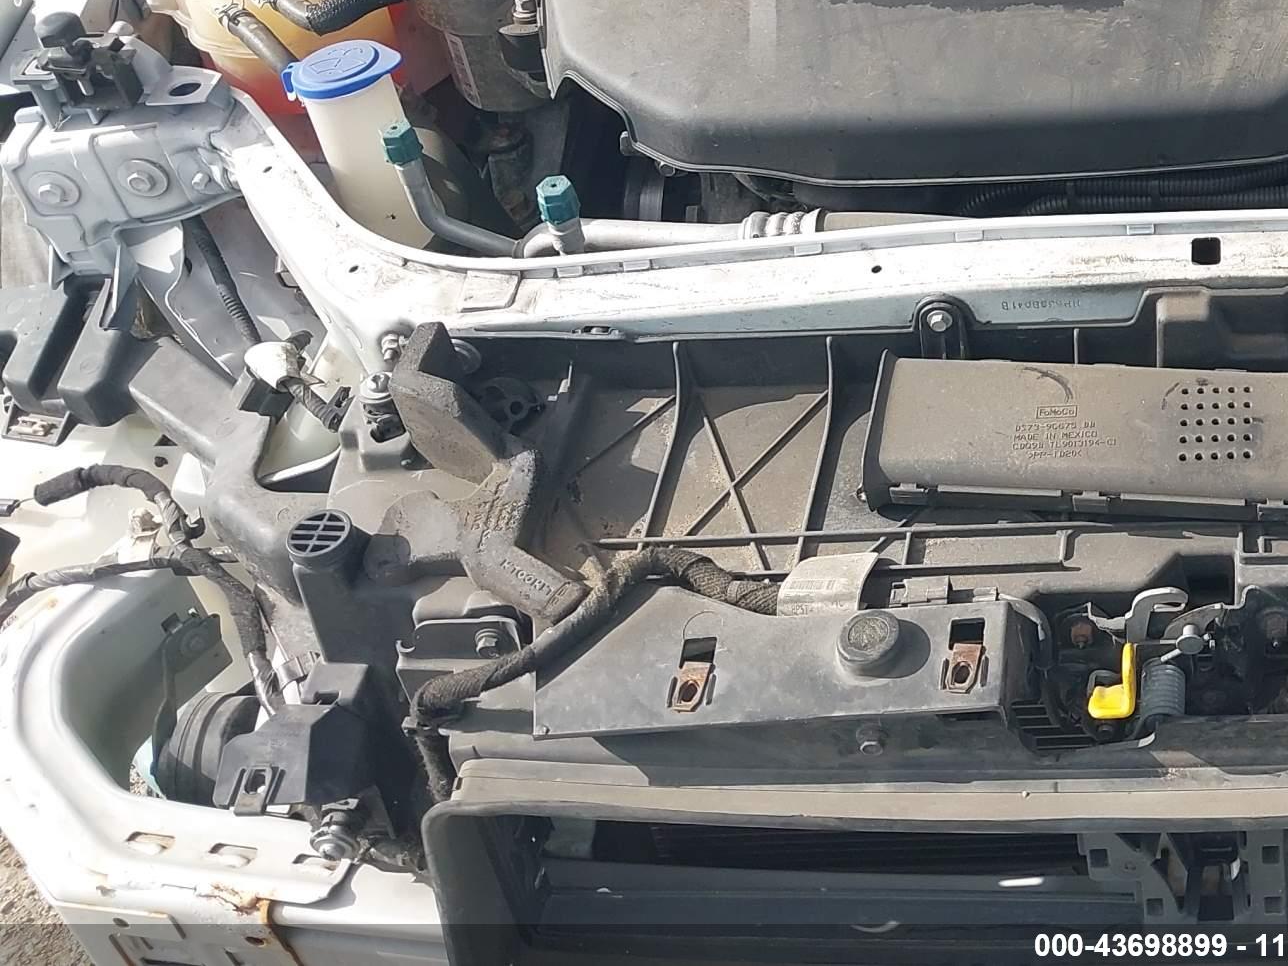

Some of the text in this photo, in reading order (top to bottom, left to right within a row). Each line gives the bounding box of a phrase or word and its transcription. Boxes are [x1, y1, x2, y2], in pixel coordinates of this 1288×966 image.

[1039, 408, 1076, 418] FoMoCo
[1013, 430, 1098, 442] MADE IN MEXICO
